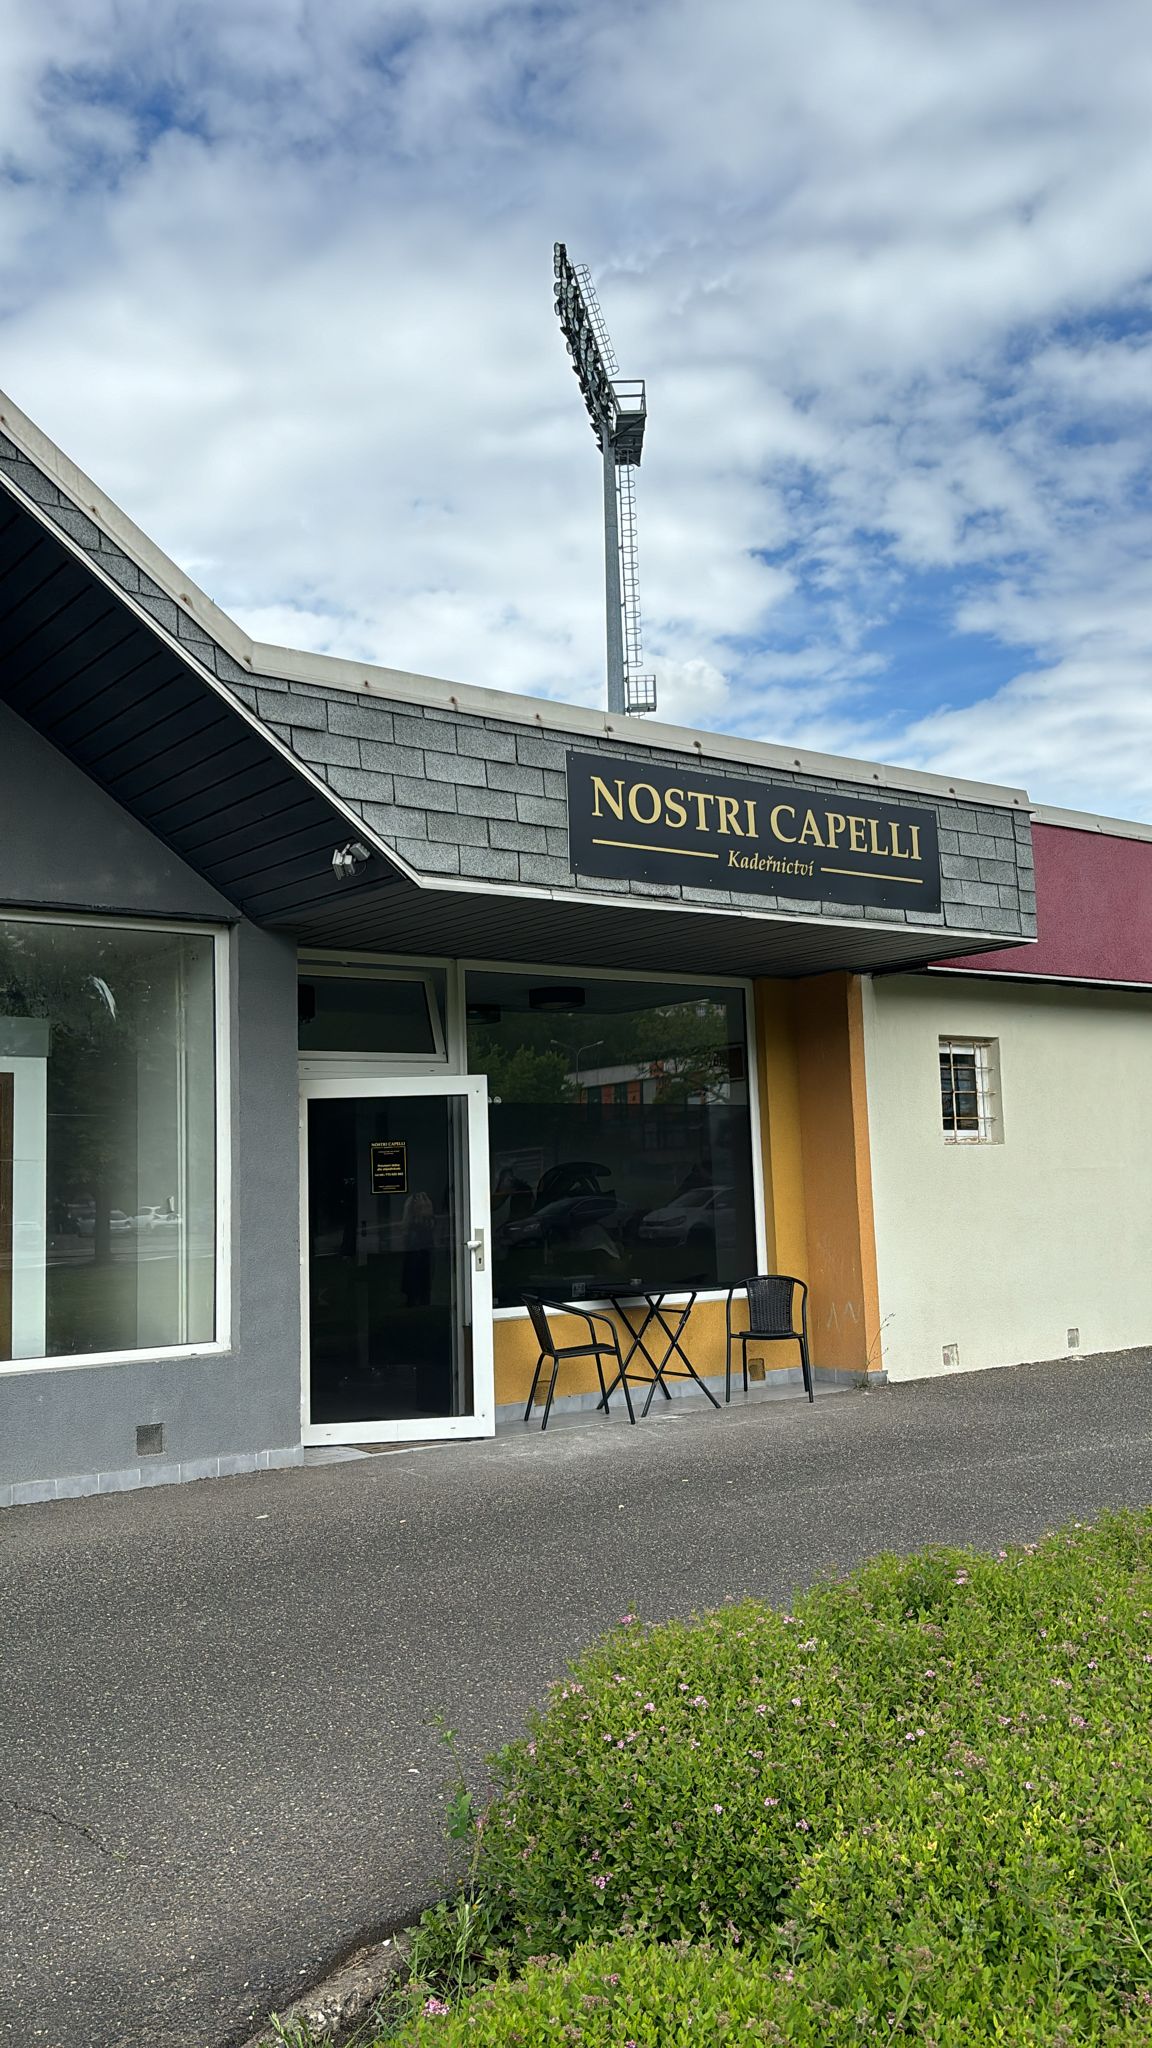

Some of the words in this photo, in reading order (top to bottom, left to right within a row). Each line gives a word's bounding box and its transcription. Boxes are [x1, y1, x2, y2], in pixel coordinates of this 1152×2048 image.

[590, 775, 759, 838] NOSTRI
[770, 804, 923, 861] CAPELLI
[727, 849, 814, 877] Kadeřnictví
